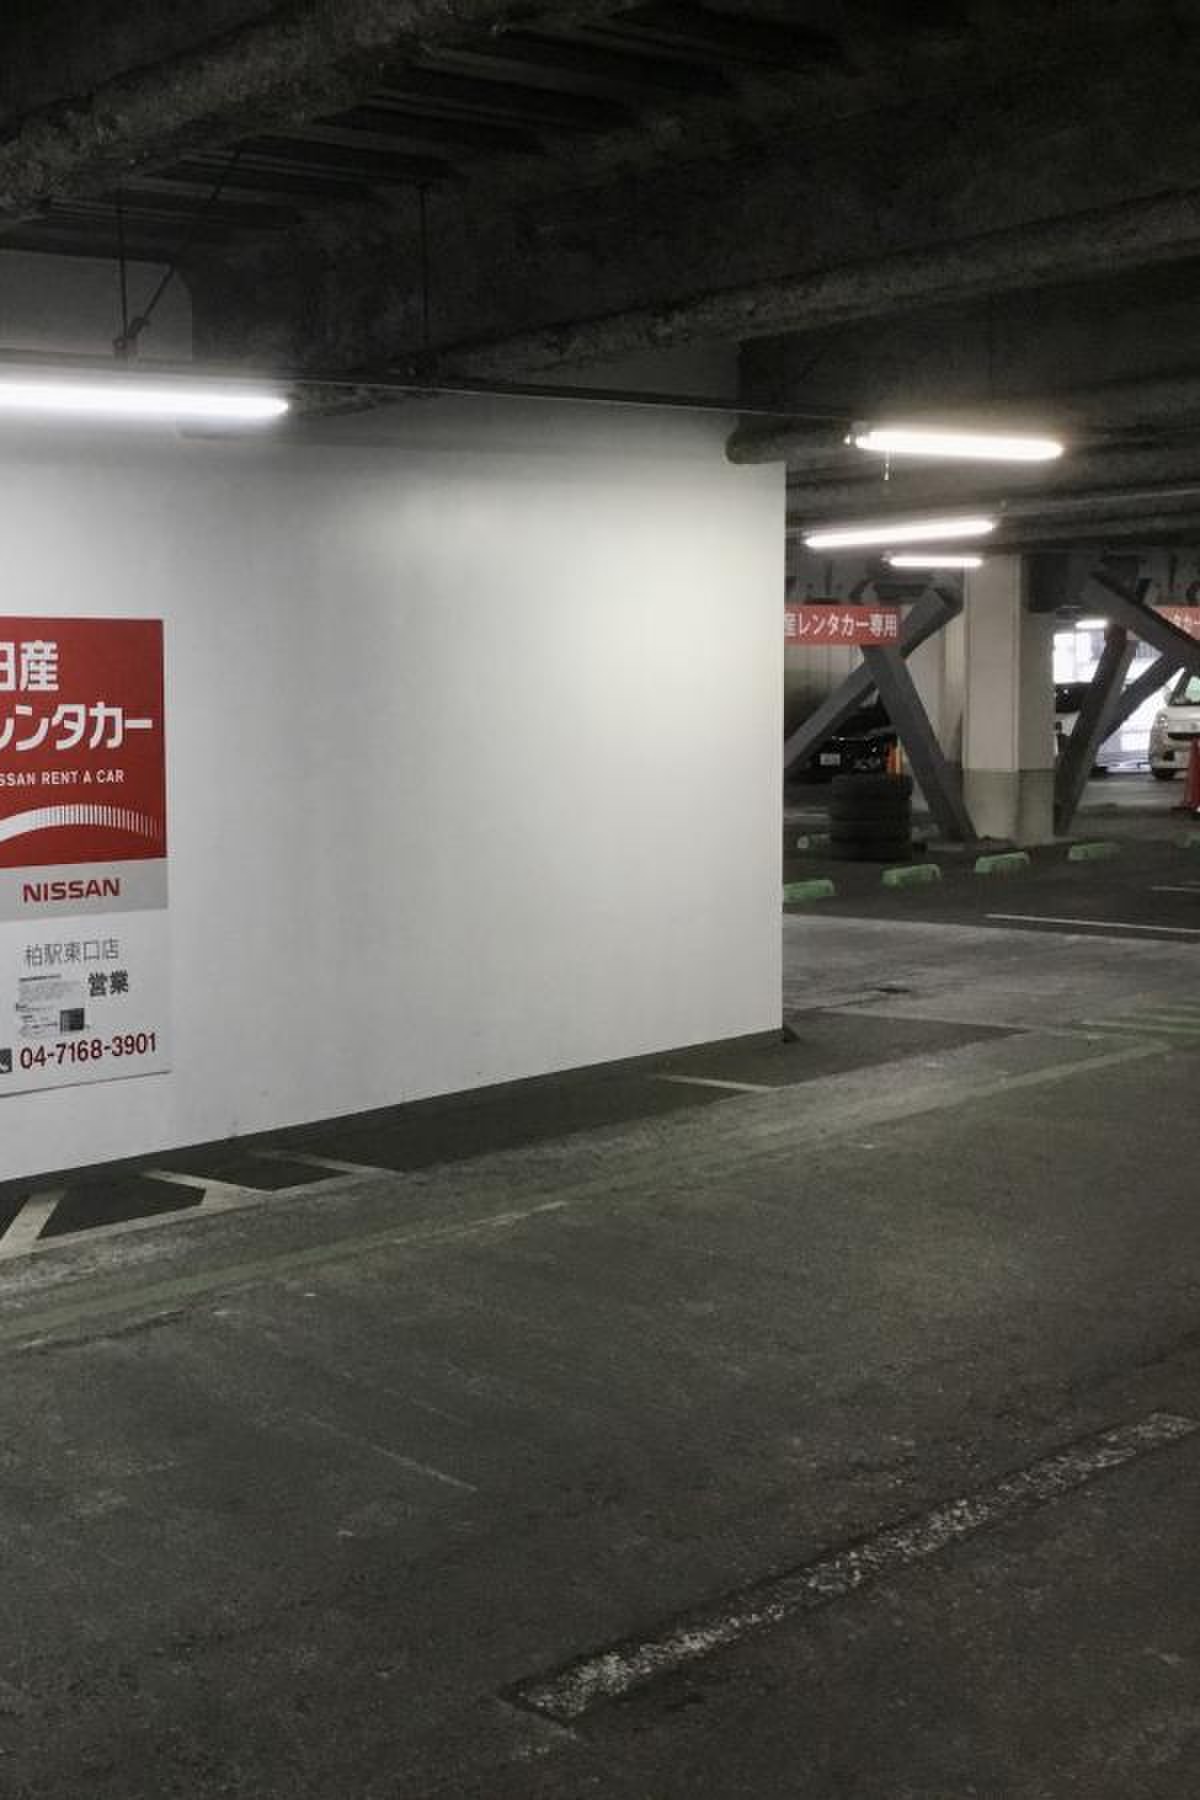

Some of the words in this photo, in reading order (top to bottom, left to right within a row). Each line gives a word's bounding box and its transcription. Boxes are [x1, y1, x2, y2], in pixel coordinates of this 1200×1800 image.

[41, 771, 78, 785] RENT
[83, 771, 92, 784] A
[96, 769, 125, 783] CAR
[22, 878, 121, 903] NISSAN
[25, 939, 119, 968] 柏駅東口店
[87, 970, 129, 997] 営業
[19, 1032, 156, 1069] 04-7168-3901
